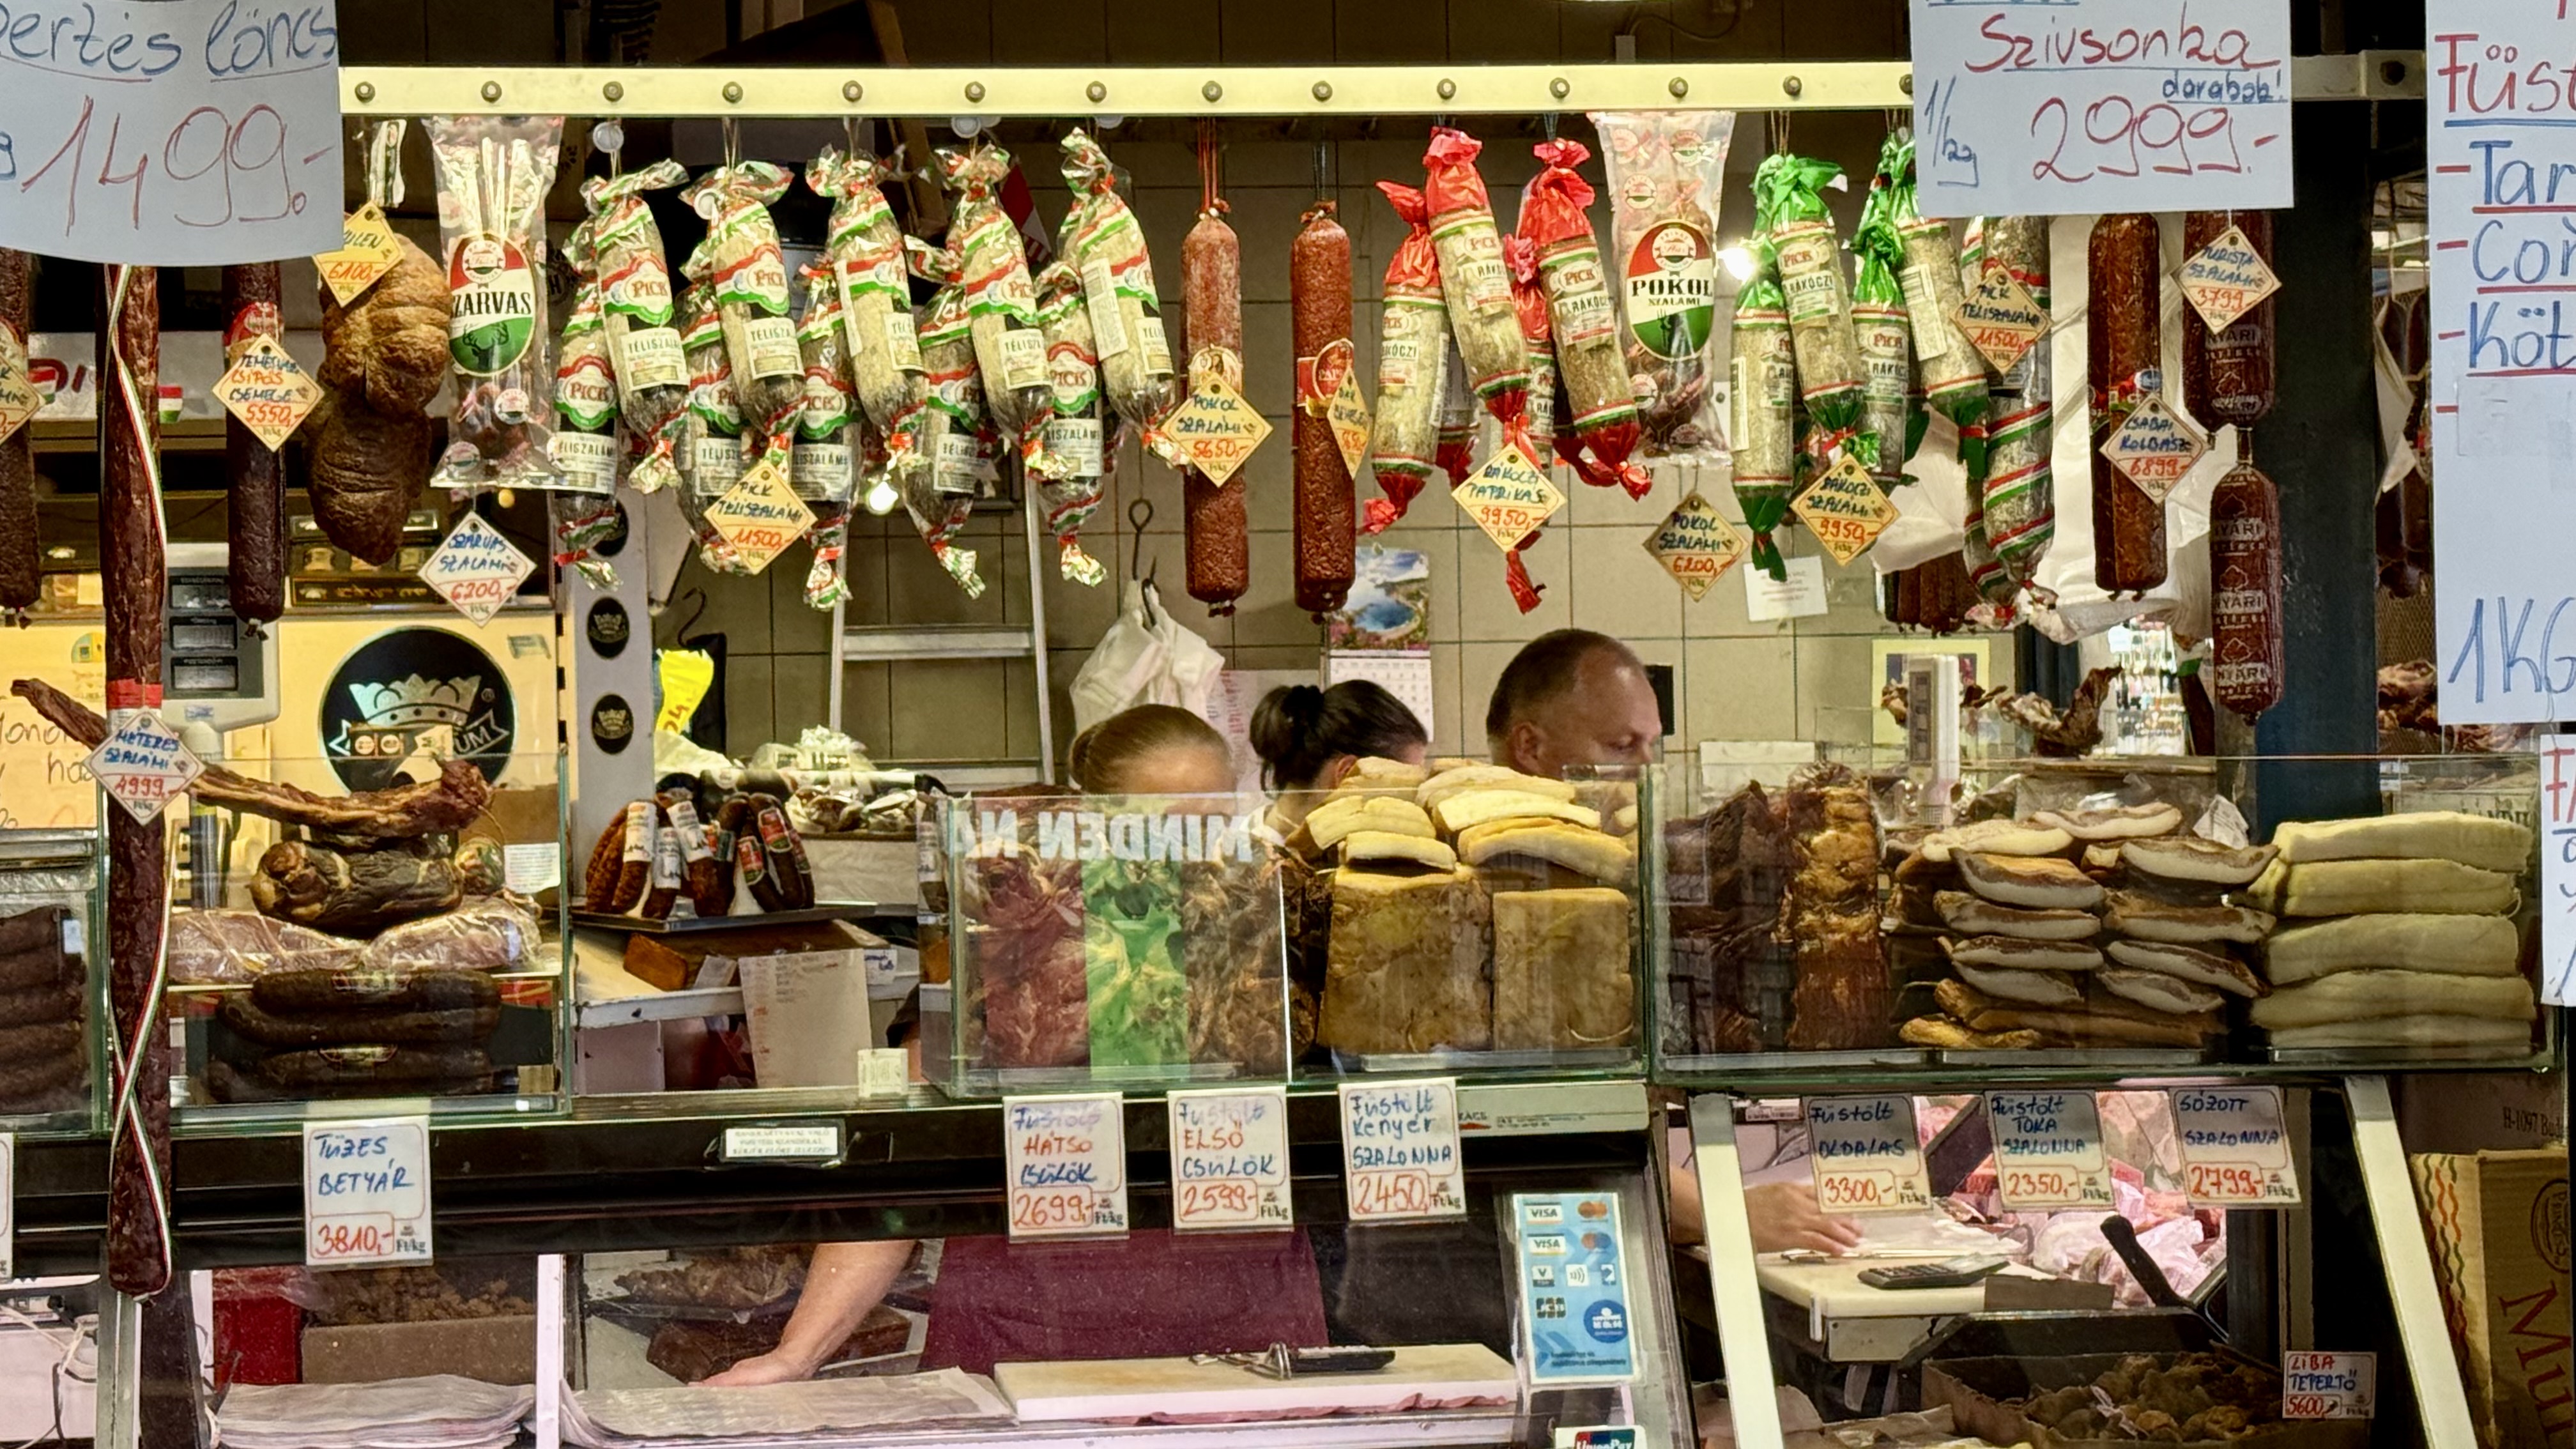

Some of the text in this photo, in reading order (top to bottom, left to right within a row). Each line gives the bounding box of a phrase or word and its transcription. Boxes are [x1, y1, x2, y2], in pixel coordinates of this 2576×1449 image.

[0, 2, 181, 75] ertés
[1632, 279, 1713, 297] POKOL
[451, 291, 532, 318] ZARVAS
[569, 381, 608, 402] PICK
[1809, 1101, 1894, 1124] Füstölt
[2011, 1116, 2058, 1134] TOKA
[1818, 1138, 1906, 1160] OLDALAS
[2002, 1138, 2086, 1156] SZALONNA
[2184, 1130, 2280, 1147] SZALONNA
[1353, 1144, 1452, 1170] SZALONNA
[318, 1158, 416, 1197] BETYÁR
[1531, 1208, 1559, 1218] VISA
[1533, 1239, 1561, 1249] VISA
[2288, 1369, 2358, 1392] TEPERTŐ
